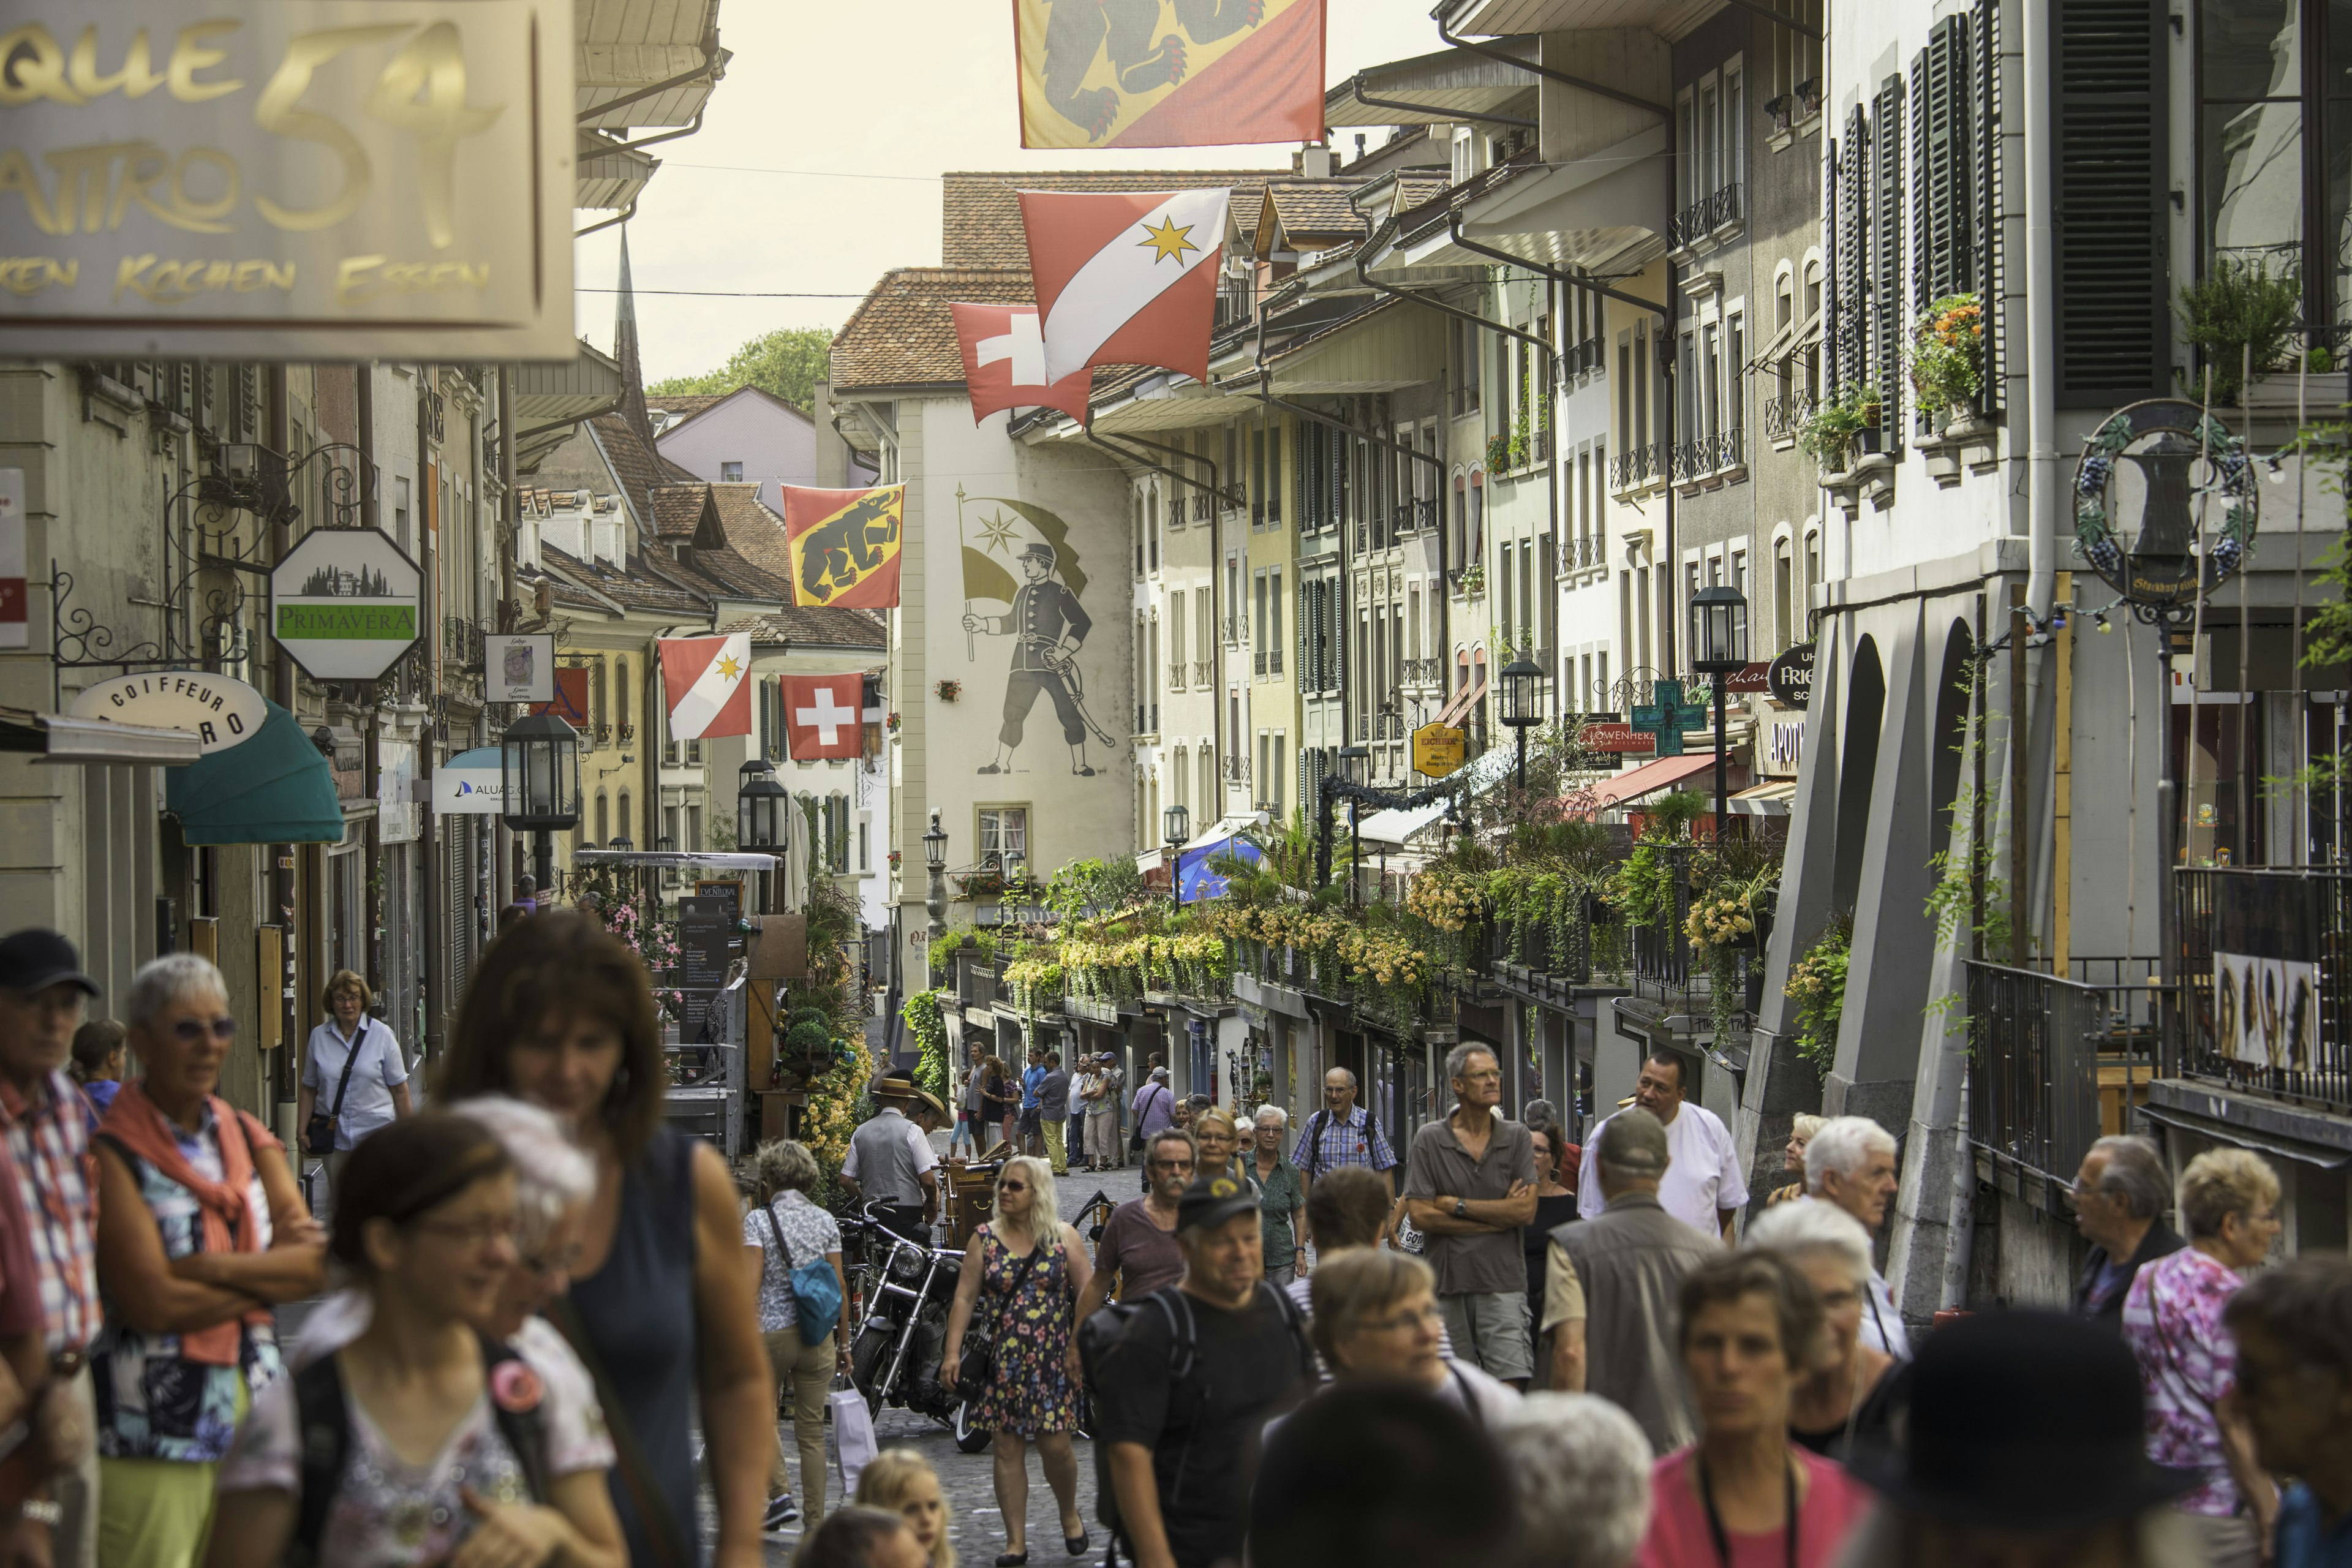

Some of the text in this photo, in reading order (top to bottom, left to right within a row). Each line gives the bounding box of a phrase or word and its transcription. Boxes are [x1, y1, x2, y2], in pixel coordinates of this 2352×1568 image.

[254, 19, 508, 249] 54
[277, 607, 415, 630] PRIMAVERA
[111, 676, 224, 712] COIFFEUR
